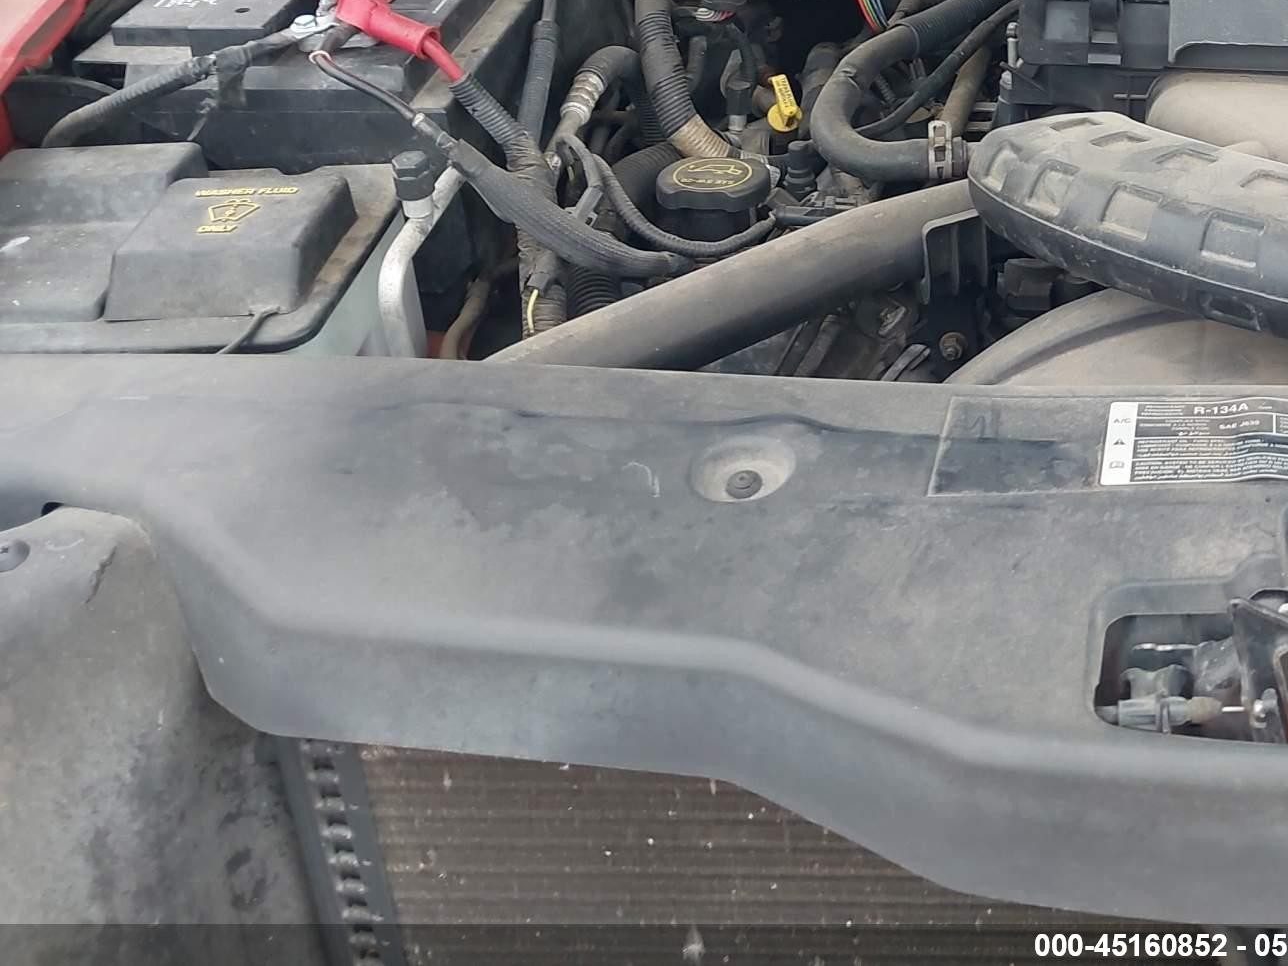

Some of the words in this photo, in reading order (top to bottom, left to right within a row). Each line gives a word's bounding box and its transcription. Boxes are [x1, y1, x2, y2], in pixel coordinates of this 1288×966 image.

[195, 187, 256, 197] WASHER
[258, 186, 299, 195] FLUID
[196, 224, 238, 233] ONLY
[1193, 402, 1249, 415] R-134A
